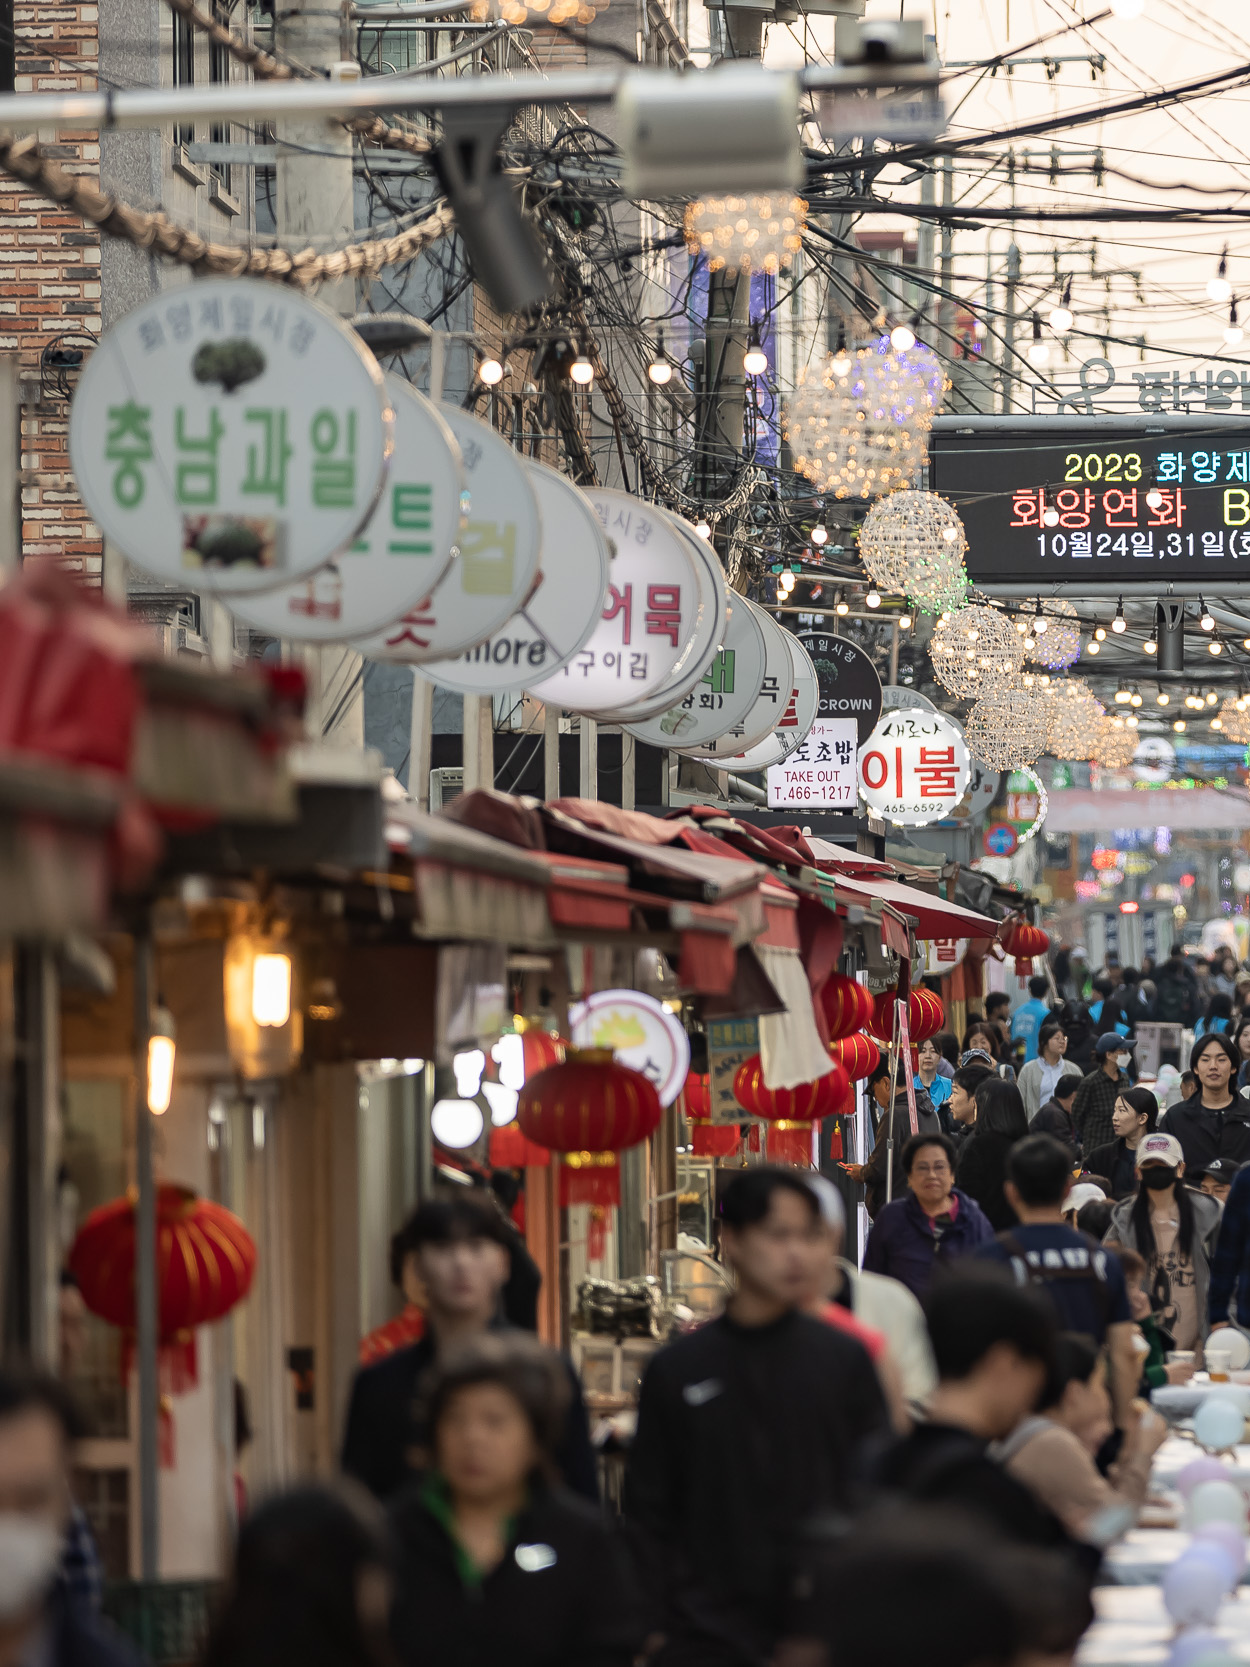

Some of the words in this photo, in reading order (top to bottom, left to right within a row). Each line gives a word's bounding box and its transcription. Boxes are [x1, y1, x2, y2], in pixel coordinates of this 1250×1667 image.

[106, 398, 356, 511] 충남과일
[1064, 453, 1144, 482] 2023
[1010, 487, 1187, 528] 화양연화
[818, 699, 873, 711] CROWN
[778, 740, 854, 765] 도초밥
[785, 771, 814, 782] TAKE
[817, 771, 840, 782] OUT
[862, 746, 961, 799] 이불
[774, 786, 851, 801] T.466-1217
[884, 803, 944, 814] 465-6592
